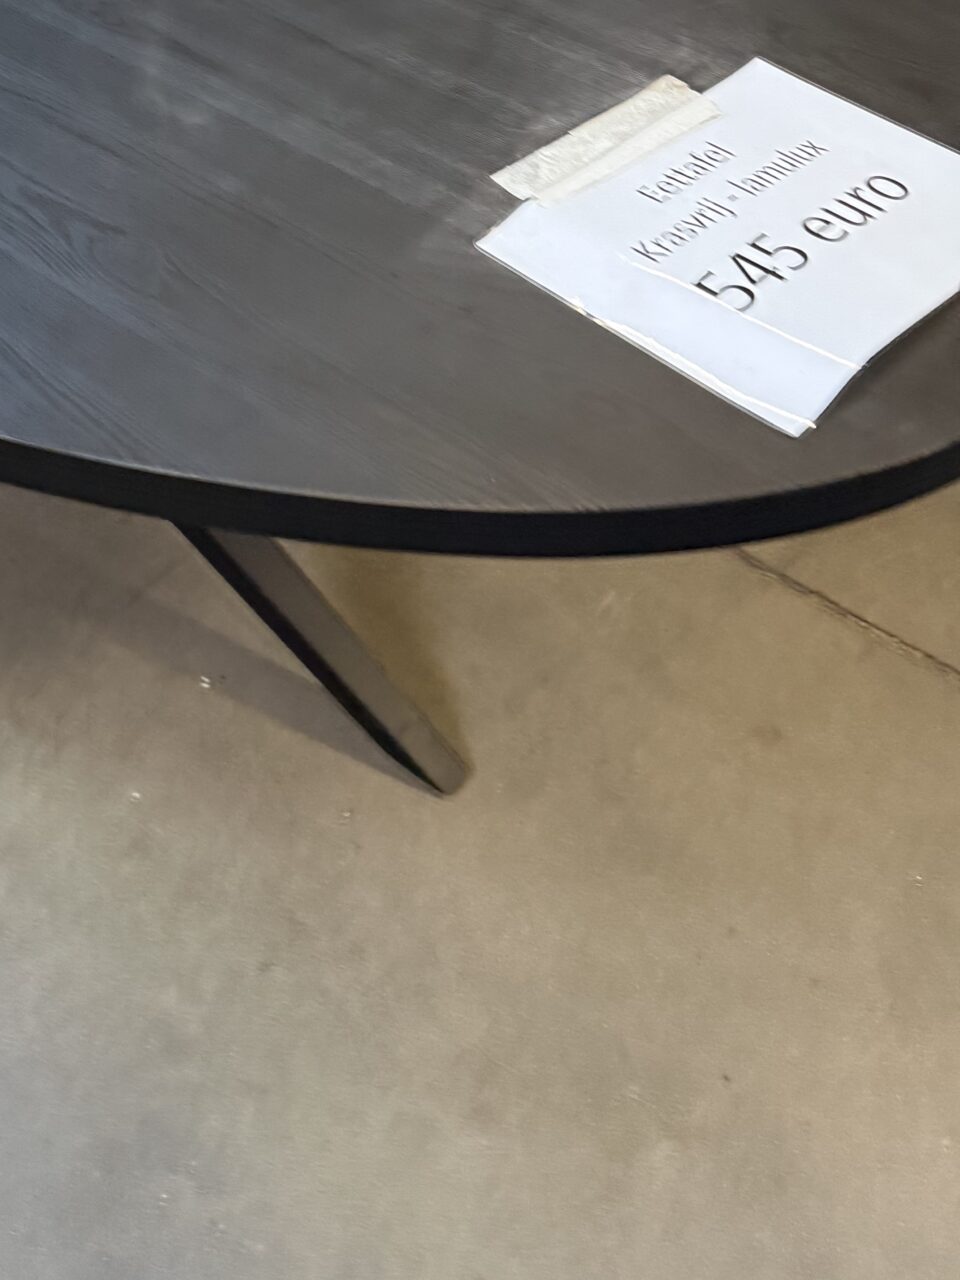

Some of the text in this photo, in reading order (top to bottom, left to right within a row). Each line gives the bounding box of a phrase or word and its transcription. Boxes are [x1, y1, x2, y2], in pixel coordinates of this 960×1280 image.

[635, 140, 737, 204] Eettafel
[630, 196, 739, 264] Krasvrij
[692, 174, 910, 312] 545 euro
